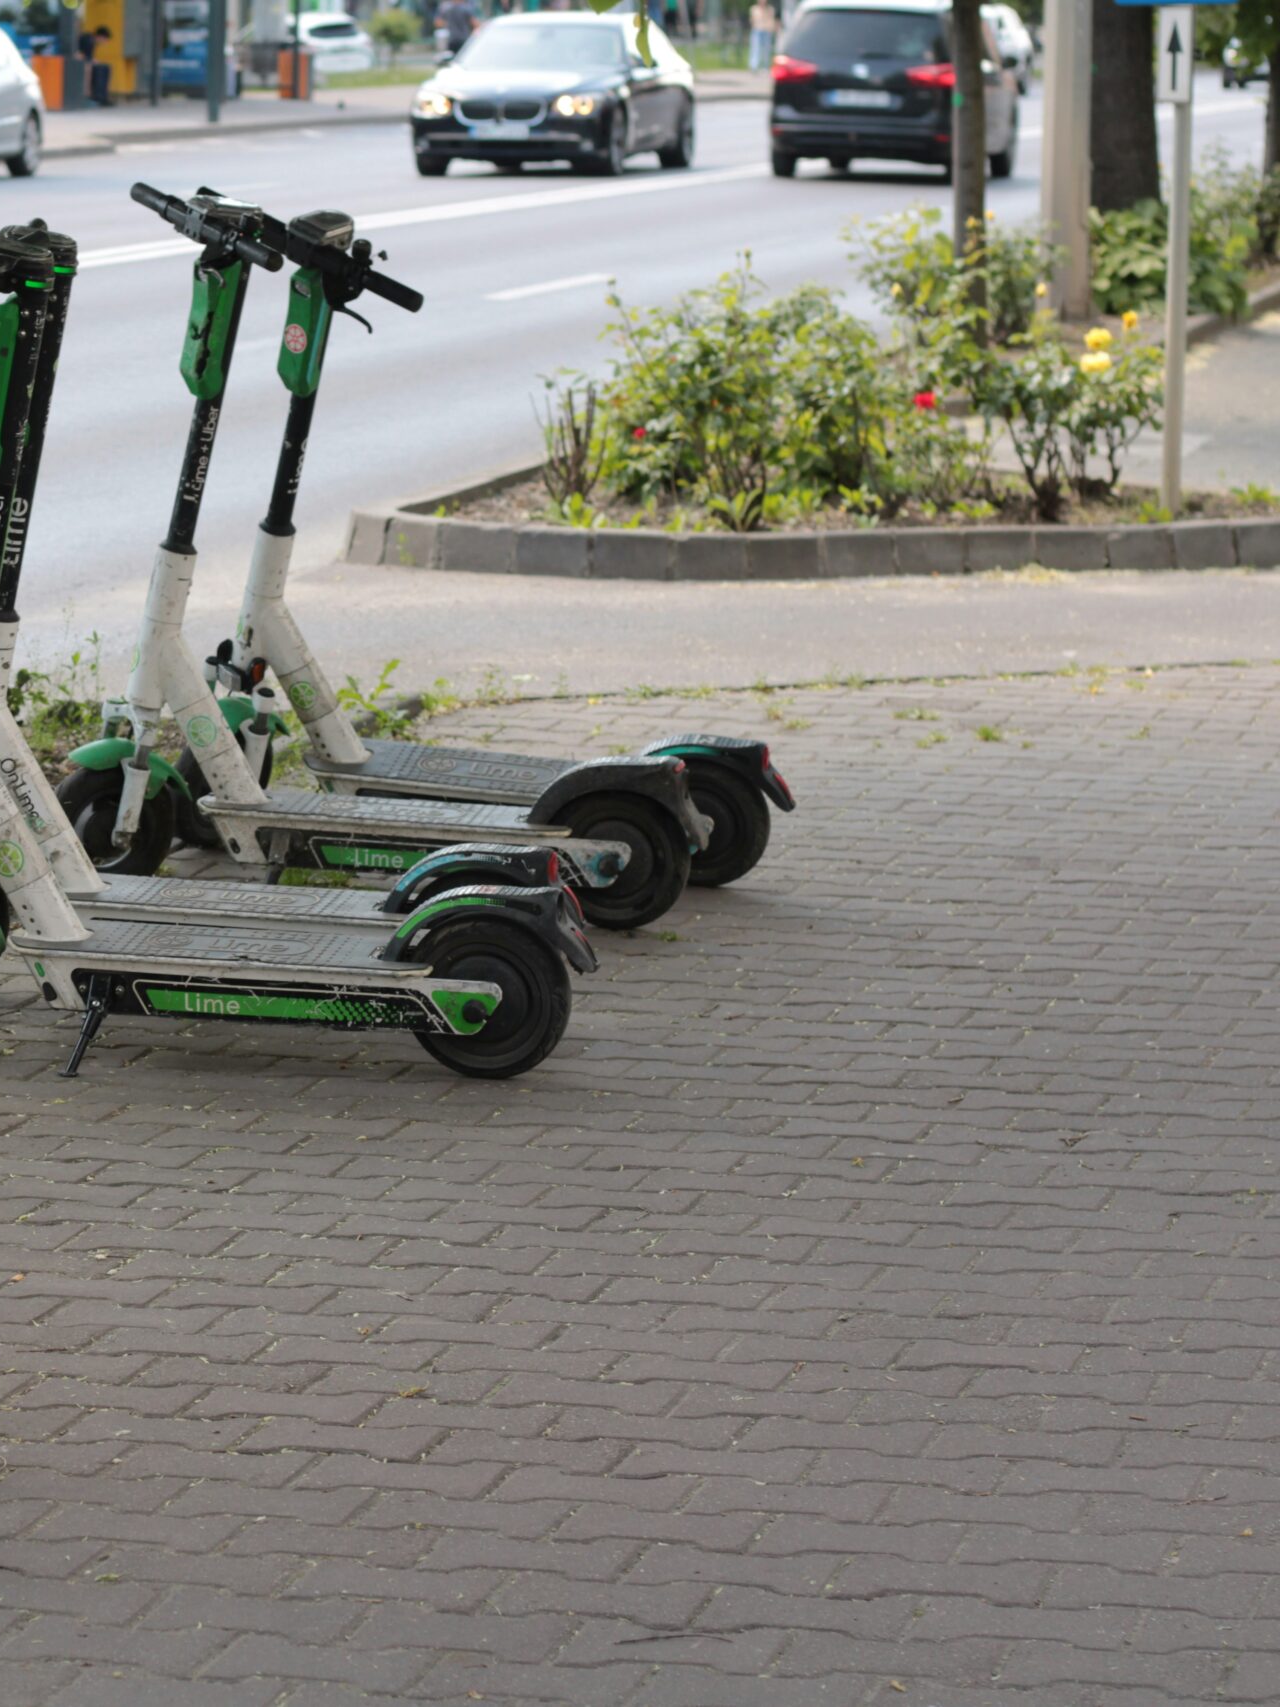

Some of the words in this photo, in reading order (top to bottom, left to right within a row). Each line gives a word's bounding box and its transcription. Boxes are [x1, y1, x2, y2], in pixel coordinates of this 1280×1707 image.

[202, 405, 220, 442] Uber
[468, 765, 538, 782] Lime
[353, 847, 404, 868] Lime
[219, 890, 297, 905] Lime
[183, 992, 241, 1015] Lime
